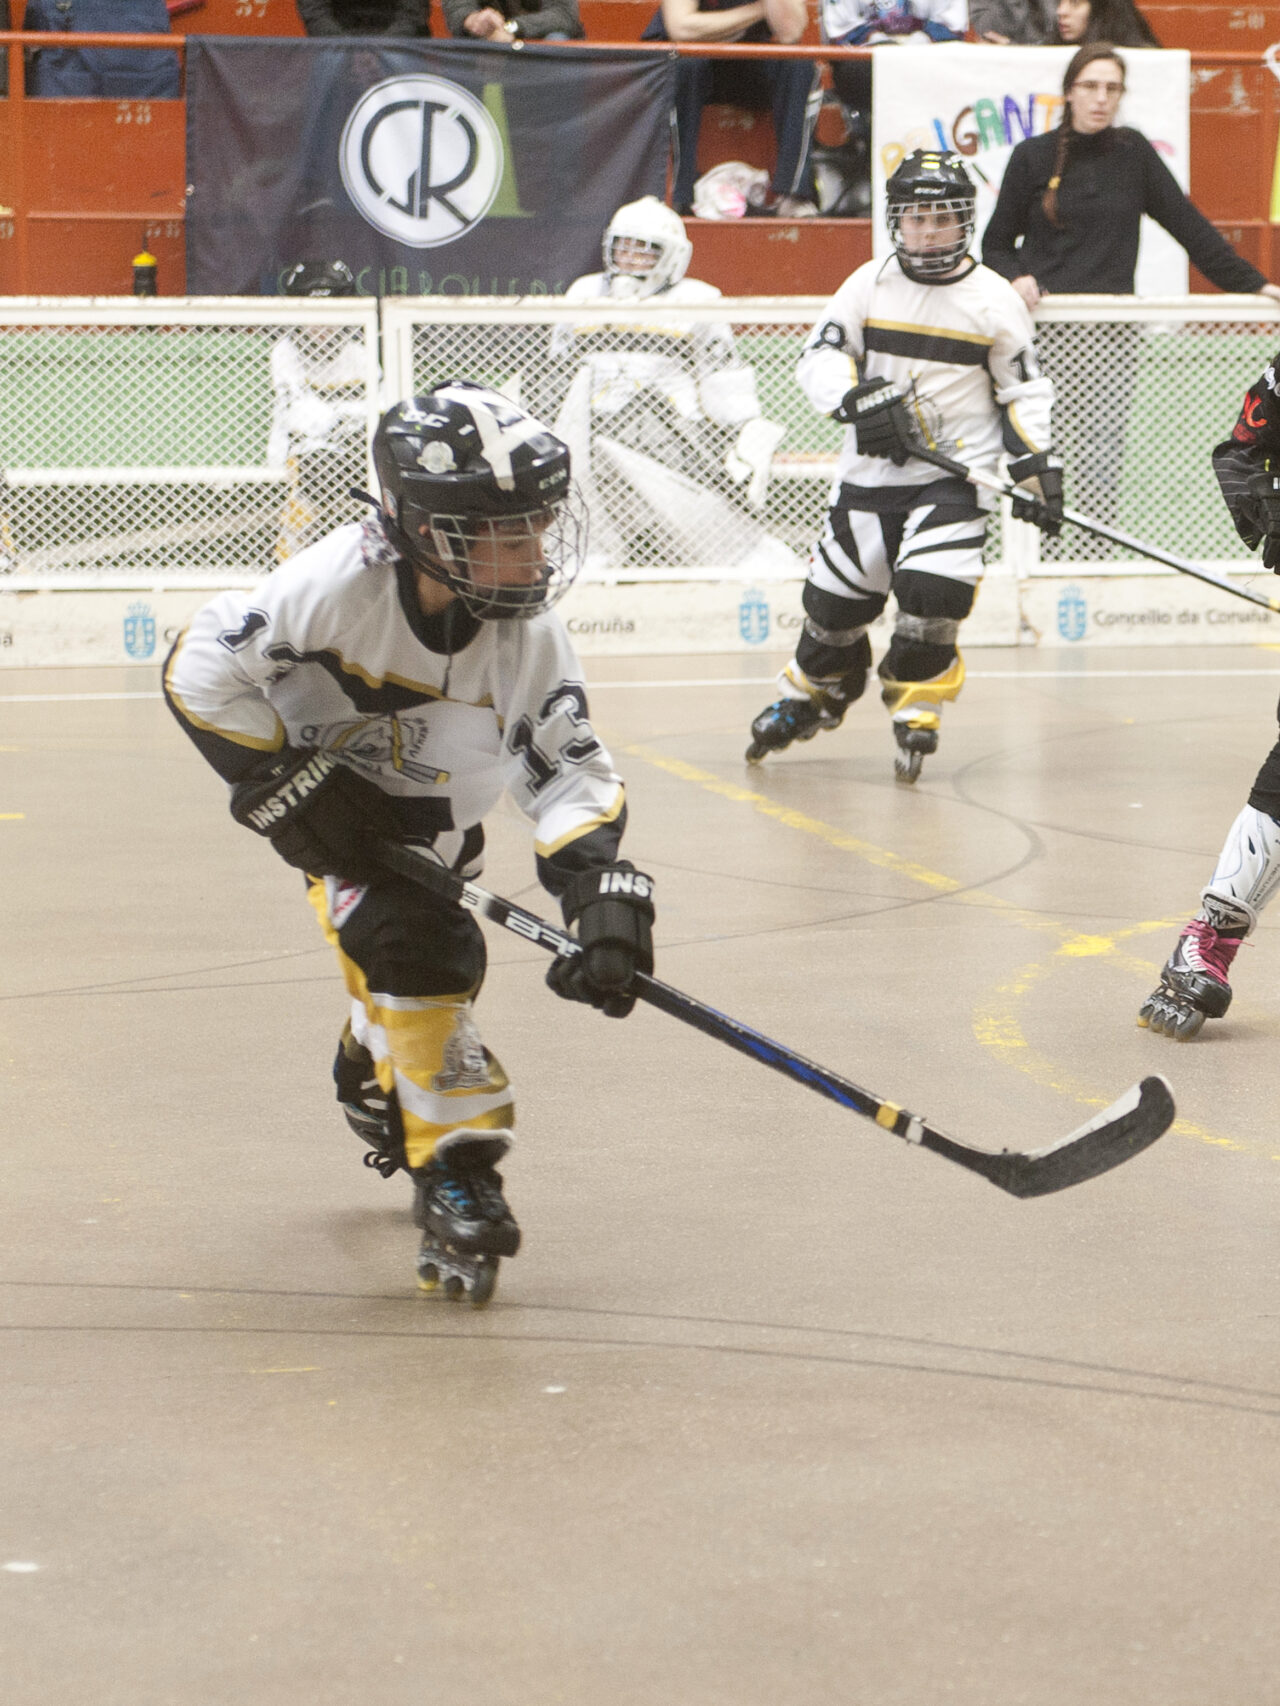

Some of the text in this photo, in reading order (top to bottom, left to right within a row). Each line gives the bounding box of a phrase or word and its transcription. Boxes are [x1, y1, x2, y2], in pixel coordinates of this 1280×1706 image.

[566, 616, 635, 634] Coruña
[1092, 608, 1171, 628] Concello
[1177, 607, 1199, 625] da
[506, 679, 602, 798] 13
